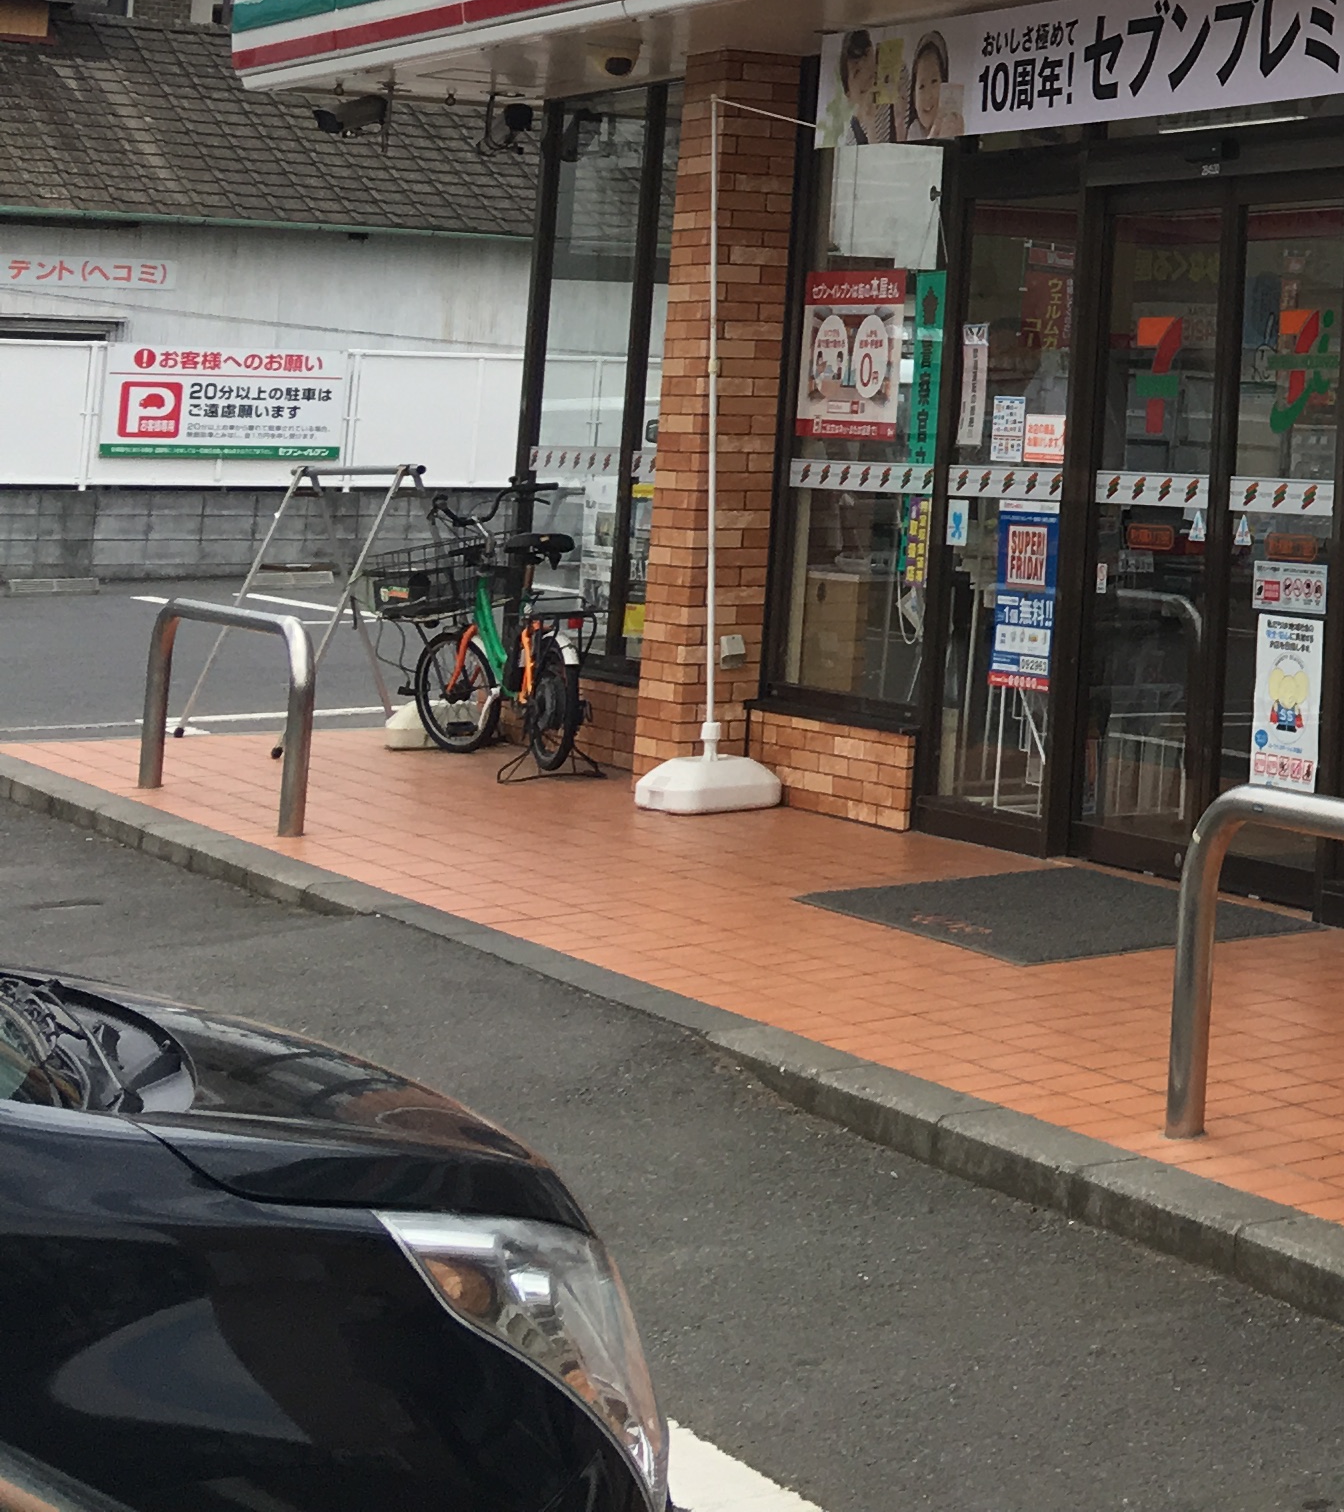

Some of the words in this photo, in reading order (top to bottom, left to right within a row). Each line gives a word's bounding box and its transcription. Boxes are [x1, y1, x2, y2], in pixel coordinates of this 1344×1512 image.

[981, 18, 1079, 58] おいしさ極めて
[978, 51, 1076, 113] 10周年!
[158, 351, 324, 373] お客様へのお願い
[188, 382, 333, 403] 20分以上の駐車は
[187, 403, 301, 419] ご遠慮願います
[1010, 555, 1045, 583] FRIDAY
